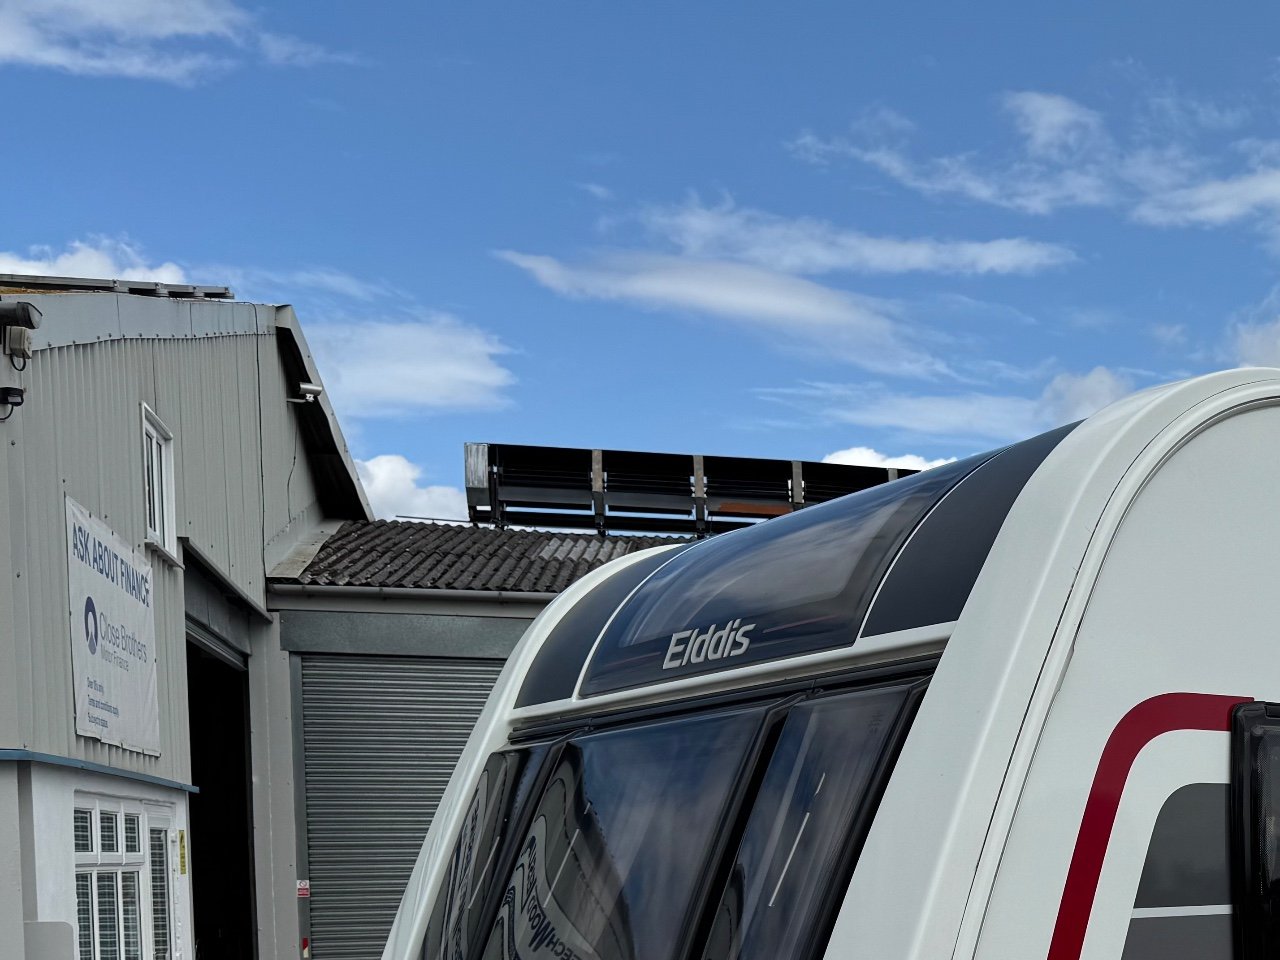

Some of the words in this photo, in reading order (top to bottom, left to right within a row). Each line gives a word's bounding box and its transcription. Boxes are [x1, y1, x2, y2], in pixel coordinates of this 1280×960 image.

[73, 522, 91, 567] ASK
[93, 537, 119, 586] ABOUT
[120, 558, 149, 607] FINANCE
[100, 612, 120, 648] Close
[121, 624, 147, 663] Brothers
[114, 651, 129, 672] Finance
[662, 618, 757, 670] Elddis
